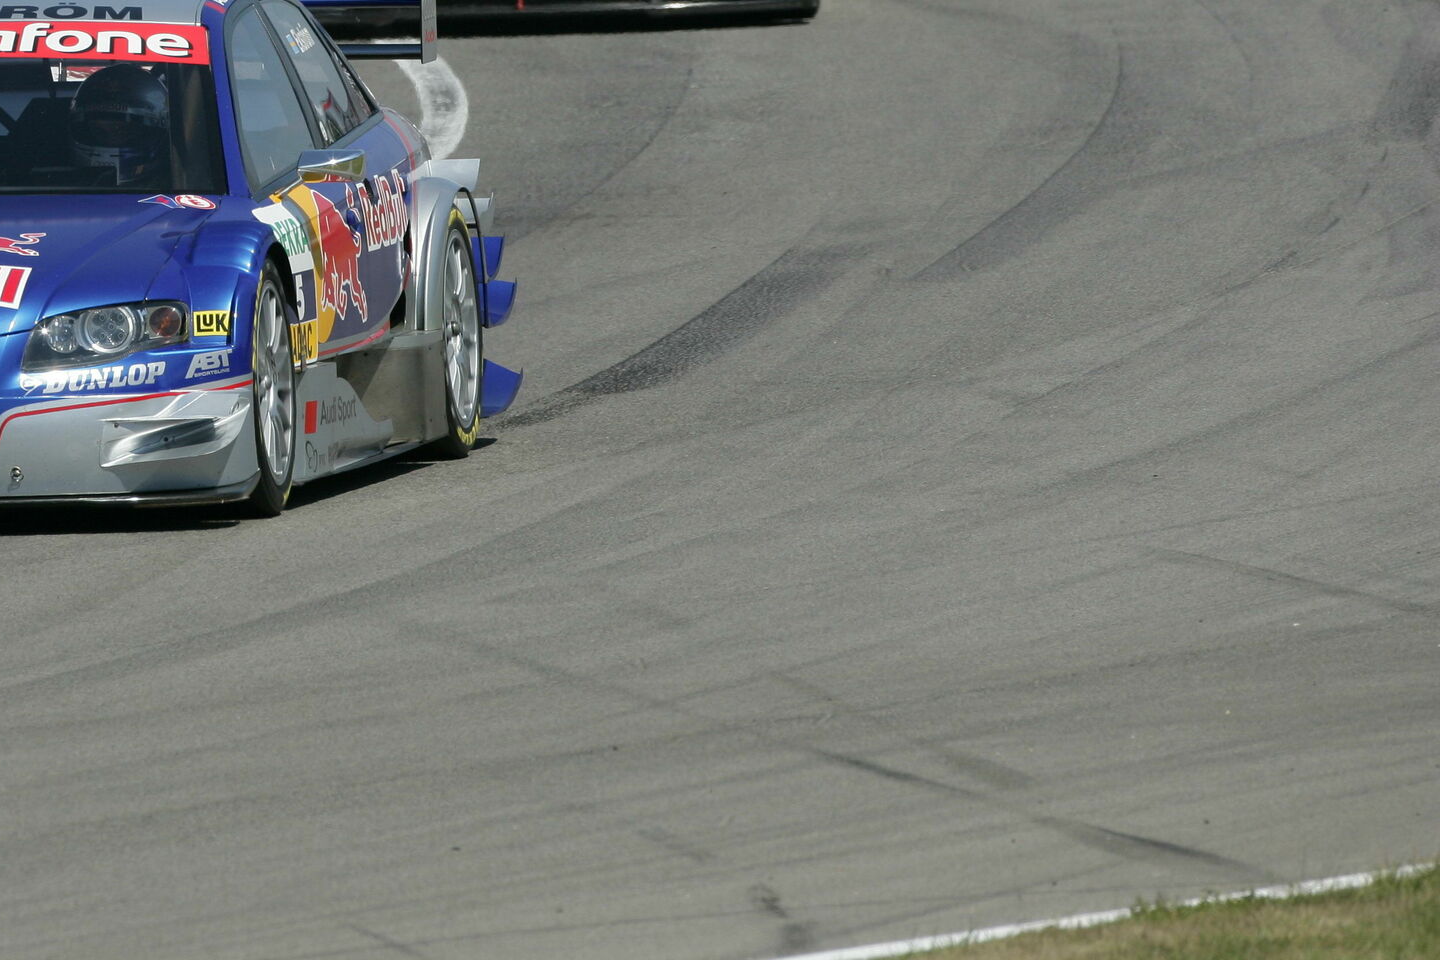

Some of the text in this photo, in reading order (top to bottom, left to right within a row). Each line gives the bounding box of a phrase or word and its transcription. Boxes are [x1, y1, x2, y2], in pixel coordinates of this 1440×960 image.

[295, 274, 305, 321] 5
[43, 361, 166, 394] DUNLOP
[185, 348, 233, 379] ABT
[319, 394, 357, 426] Audi Sport
